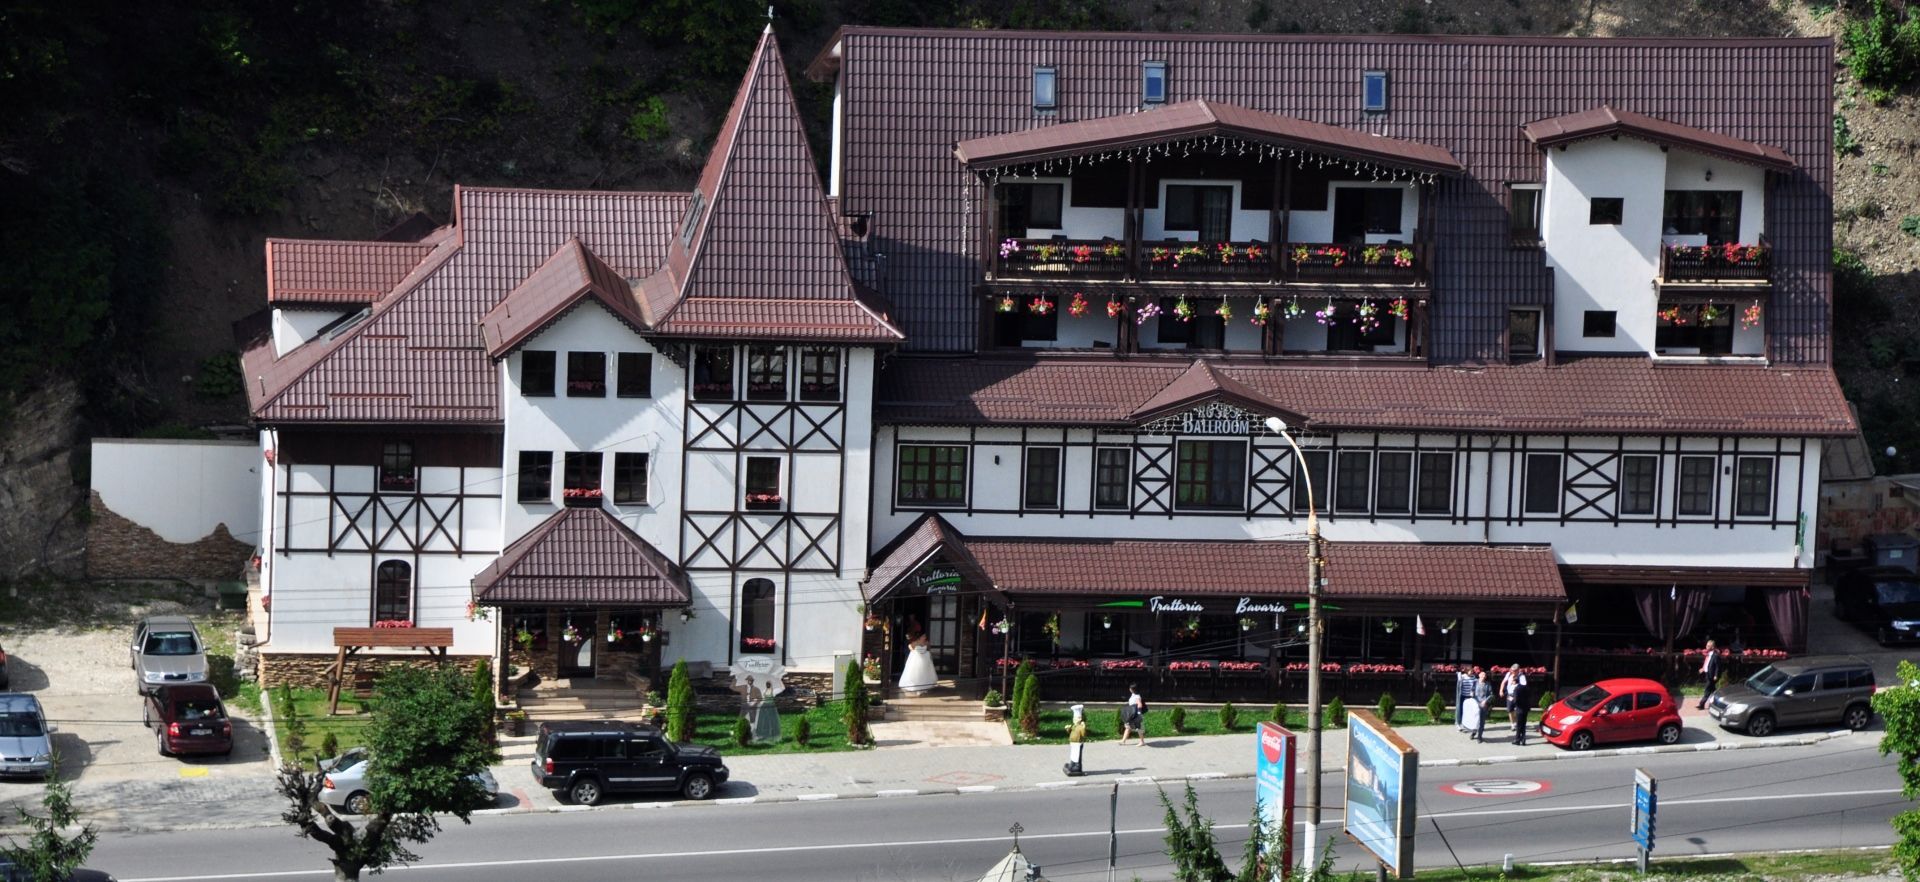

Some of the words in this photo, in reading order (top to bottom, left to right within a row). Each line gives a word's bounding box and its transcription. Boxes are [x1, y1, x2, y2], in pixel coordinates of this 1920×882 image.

[1184, 413, 1249, 434] BALLROOM
[914, 569, 960, 587] Trattoria
[1150, 596, 1204, 613] Trattoria
[1235, 597, 1288, 613] Bavaria
